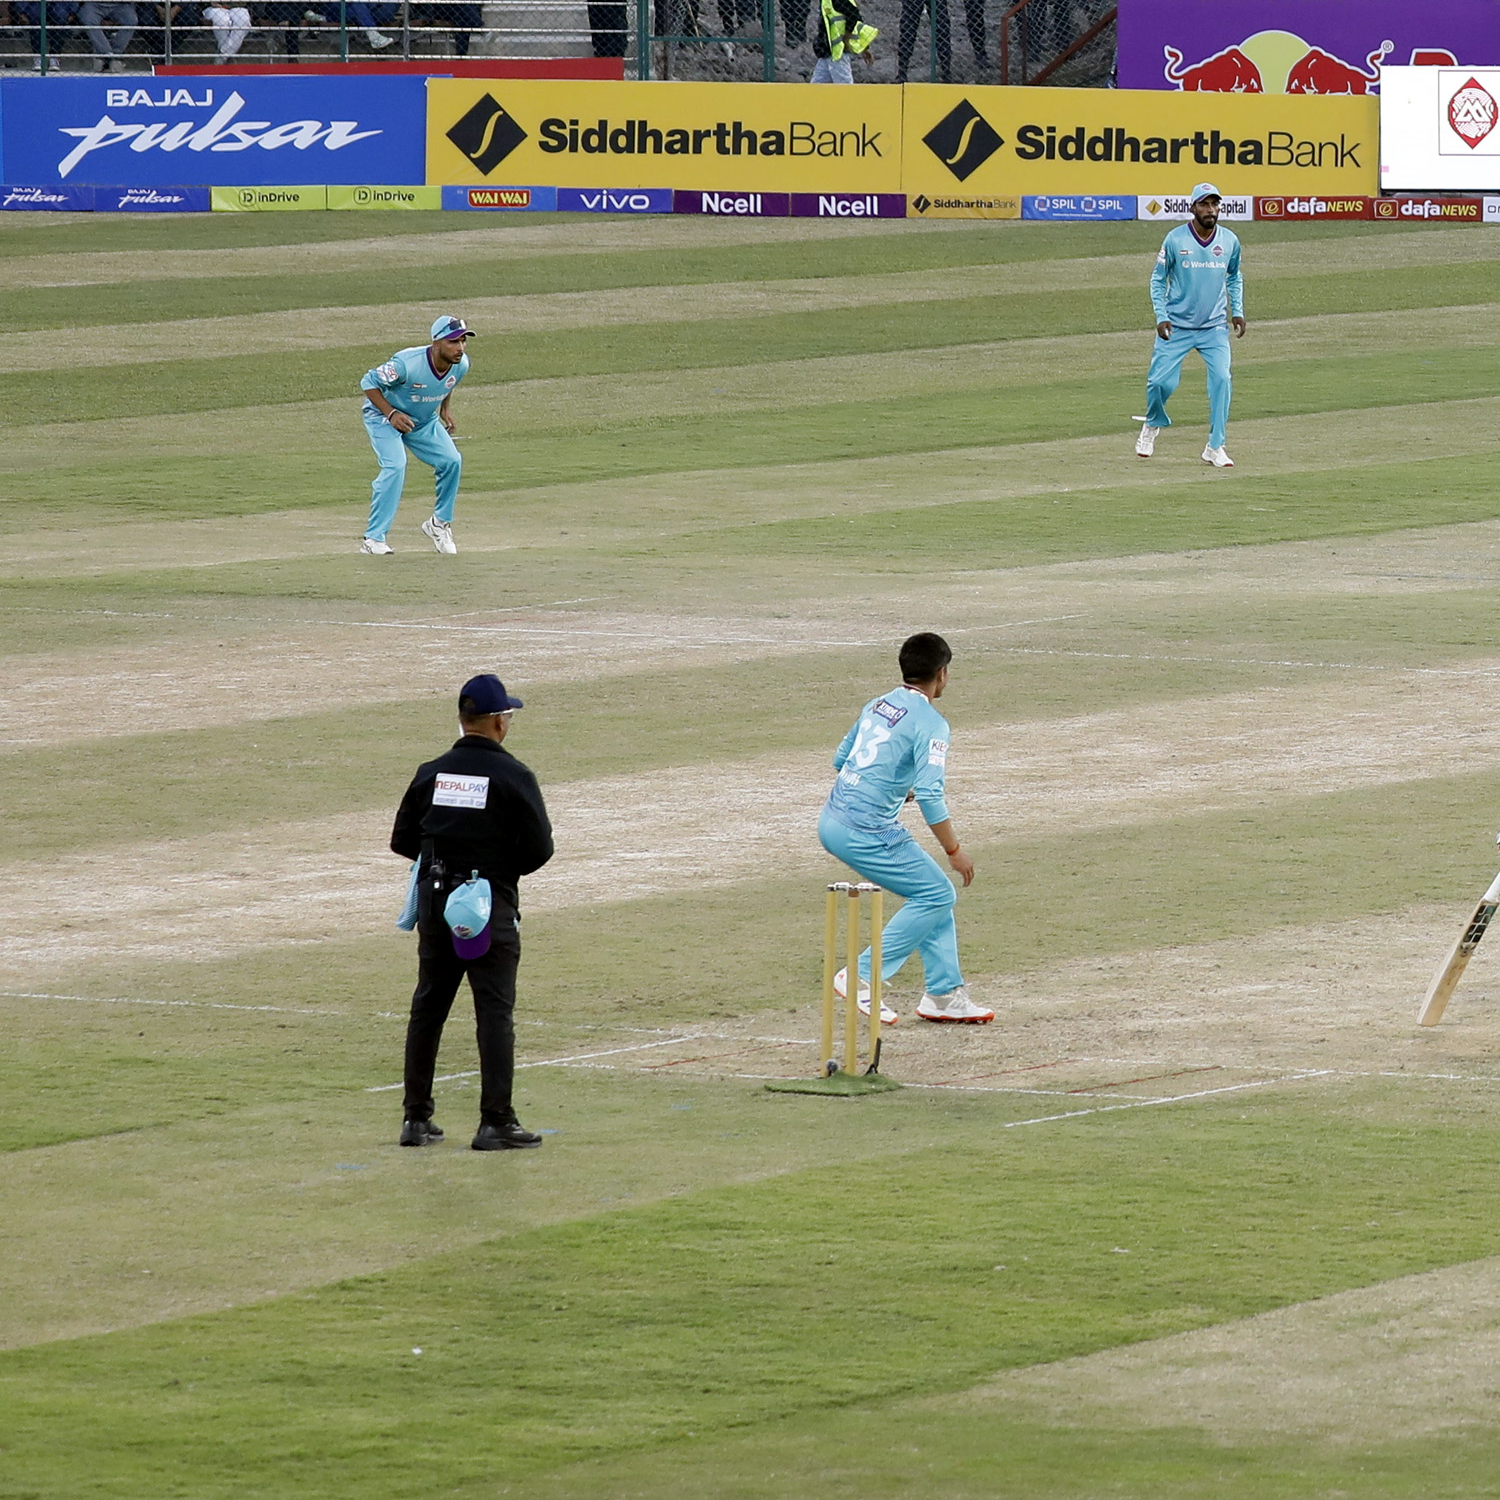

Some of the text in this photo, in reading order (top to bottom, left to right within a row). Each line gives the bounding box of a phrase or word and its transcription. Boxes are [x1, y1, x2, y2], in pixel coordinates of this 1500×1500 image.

[106, 88, 214, 107] BAJAJ
[58, 91, 383, 179] pulsar
[3, 190, 69, 206] pulsar
[118, 190, 185, 208] pulsar
[257, 191, 300, 203] inDrive
[373, 190, 415, 202] inDrive
[470, 191, 528, 204] WAI WAI
[579, 189, 651, 210] vivo
[701, 192, 762, 213] Ncell
[818, 195, 878, 215] Ncell
[1051, 198, 1123, 210] SPIL SPIL
[1219, 200, 1247, 217] apital
[1289, 197, 1364, 216] dafaNEWS
[1400, 200, 1477, 218] dafaNEWS
[1190, 260, 1227, 269] WorldLink
